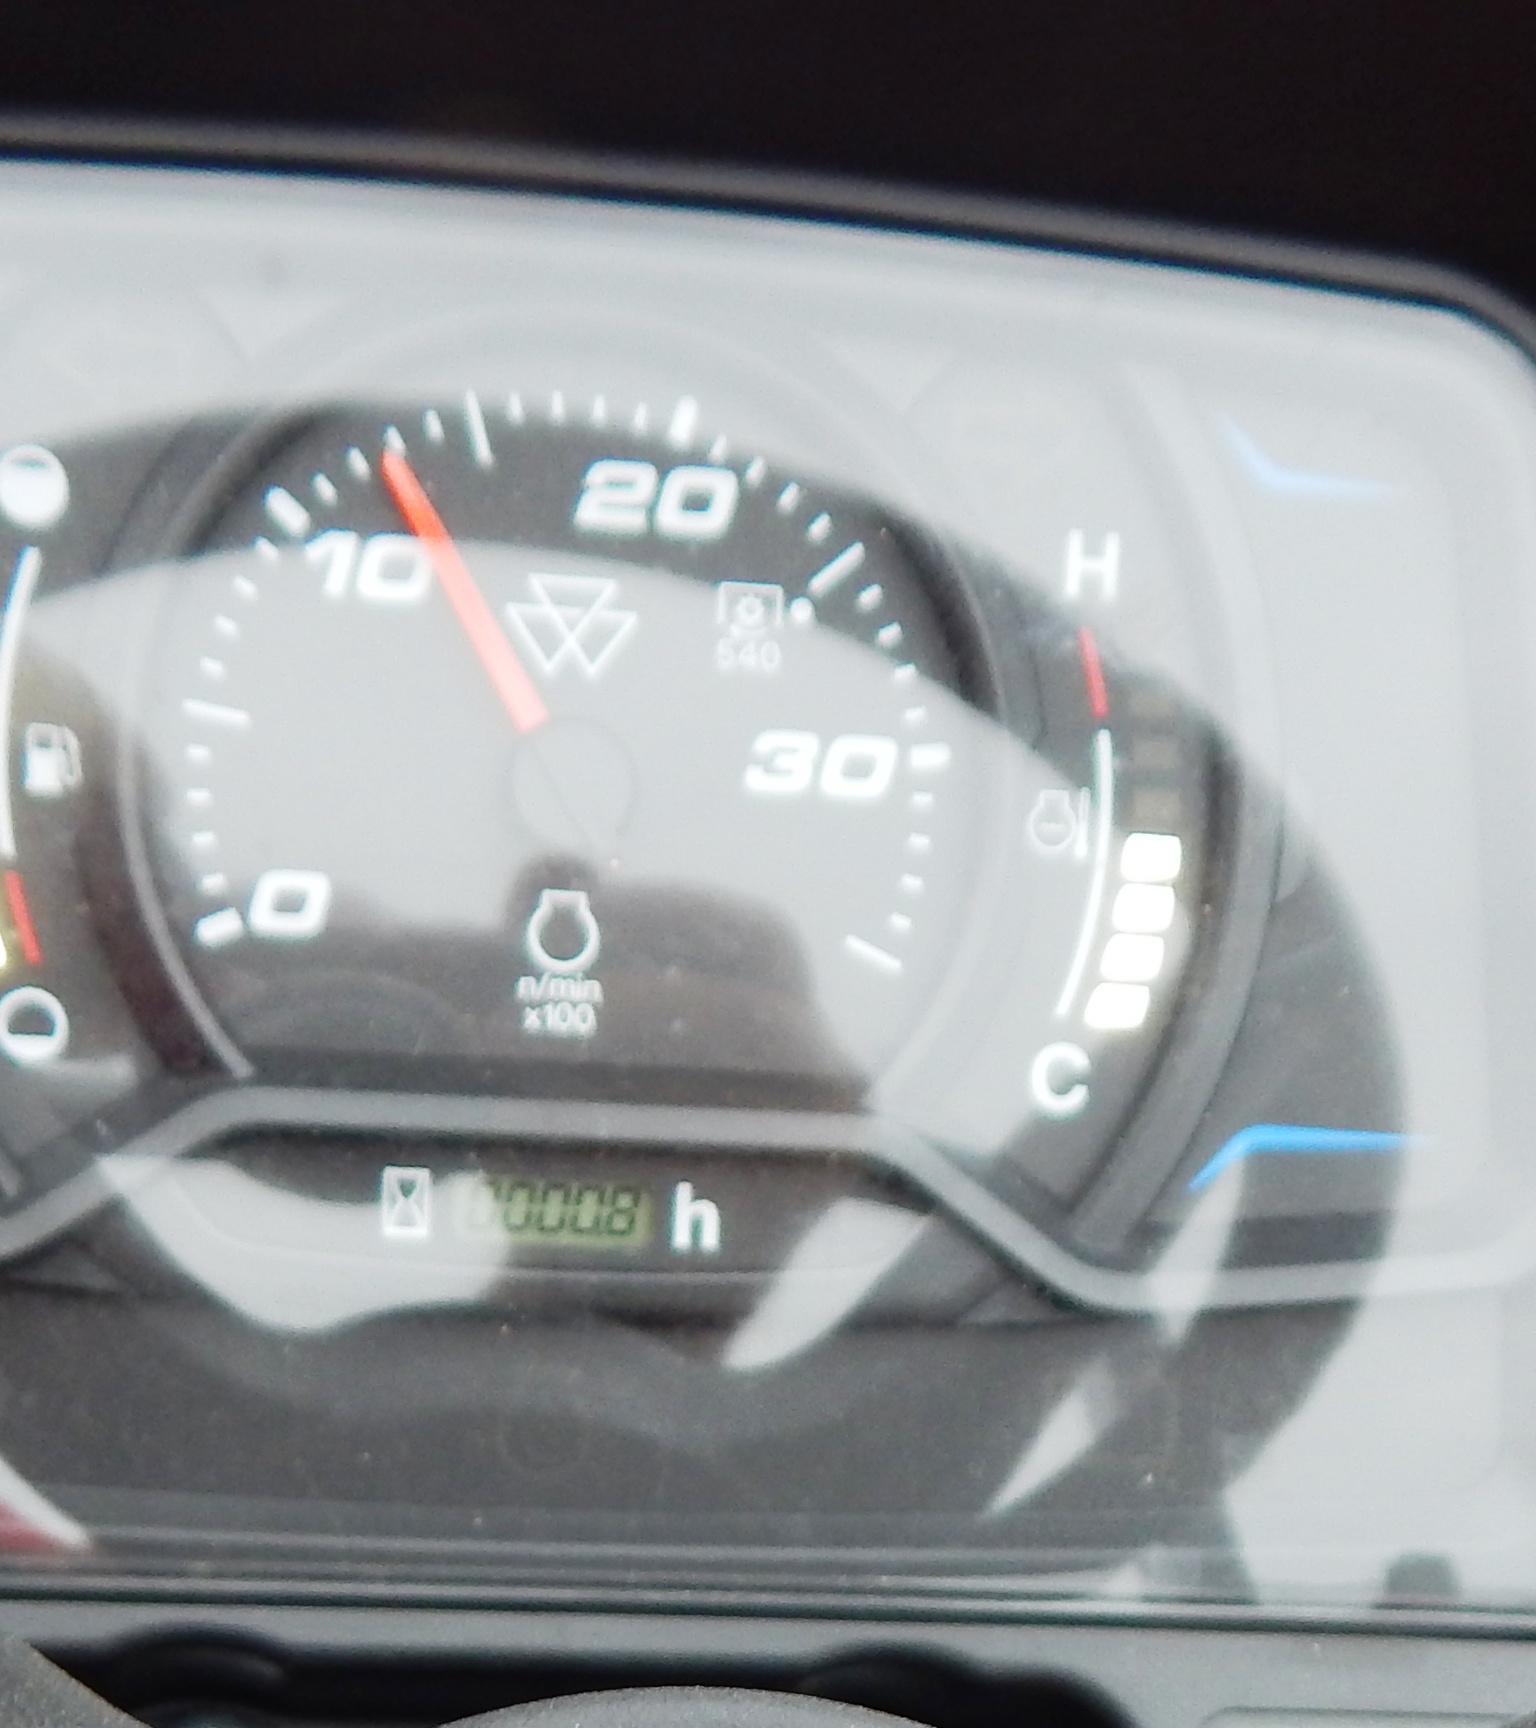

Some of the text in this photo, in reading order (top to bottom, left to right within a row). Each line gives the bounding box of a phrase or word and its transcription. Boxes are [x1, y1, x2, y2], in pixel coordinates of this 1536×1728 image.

[574, 458, 739, 538] 20
[307, 529, 432, 601] 10
[1067, 529, 1120, 600] H
[716, 637, 782, 673] 540
[743, 730, 898, 798] 30
[248, 870, 331, 937] 0
[515, 971, 603, 1004] n/min
[523, 1002, 597, 1037] x100
[1030, 1040, 1092, 1115] C
[671, 1180, 721, 1253] h
